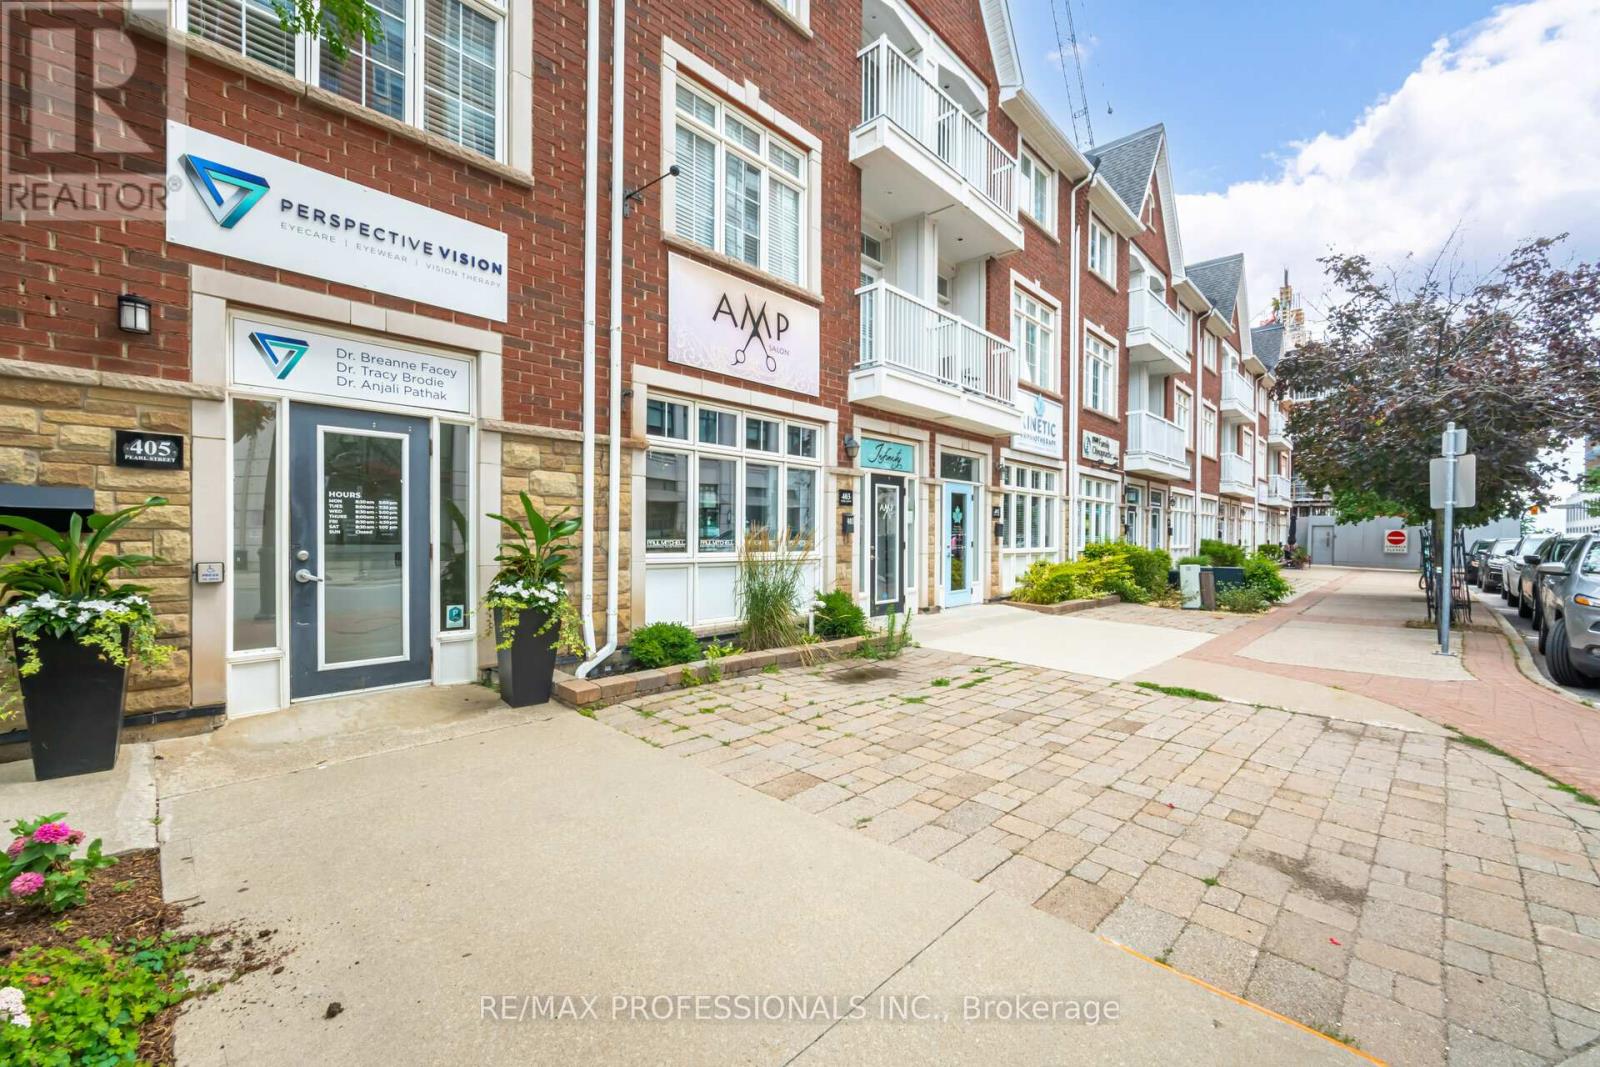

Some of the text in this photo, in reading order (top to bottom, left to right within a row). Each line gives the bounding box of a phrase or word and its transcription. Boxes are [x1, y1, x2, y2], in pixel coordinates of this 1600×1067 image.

[281, 198, 503, 276] PERSPECTIVE VISION
[280, 222, 501, 288] EYECARE EYEWEAR VISION THERAPY
[712, 292, 790, 342] AMP
[336, 347, 457, 379] Dr. Breanne Facey
[769, 344, 790, 356] SALON
[336, 361, 444, 388] Dr. Tracy Brodie
[336, 375, 447, 400] Dr. Anjali Pathak
[130, 439, 171, 456] 405
